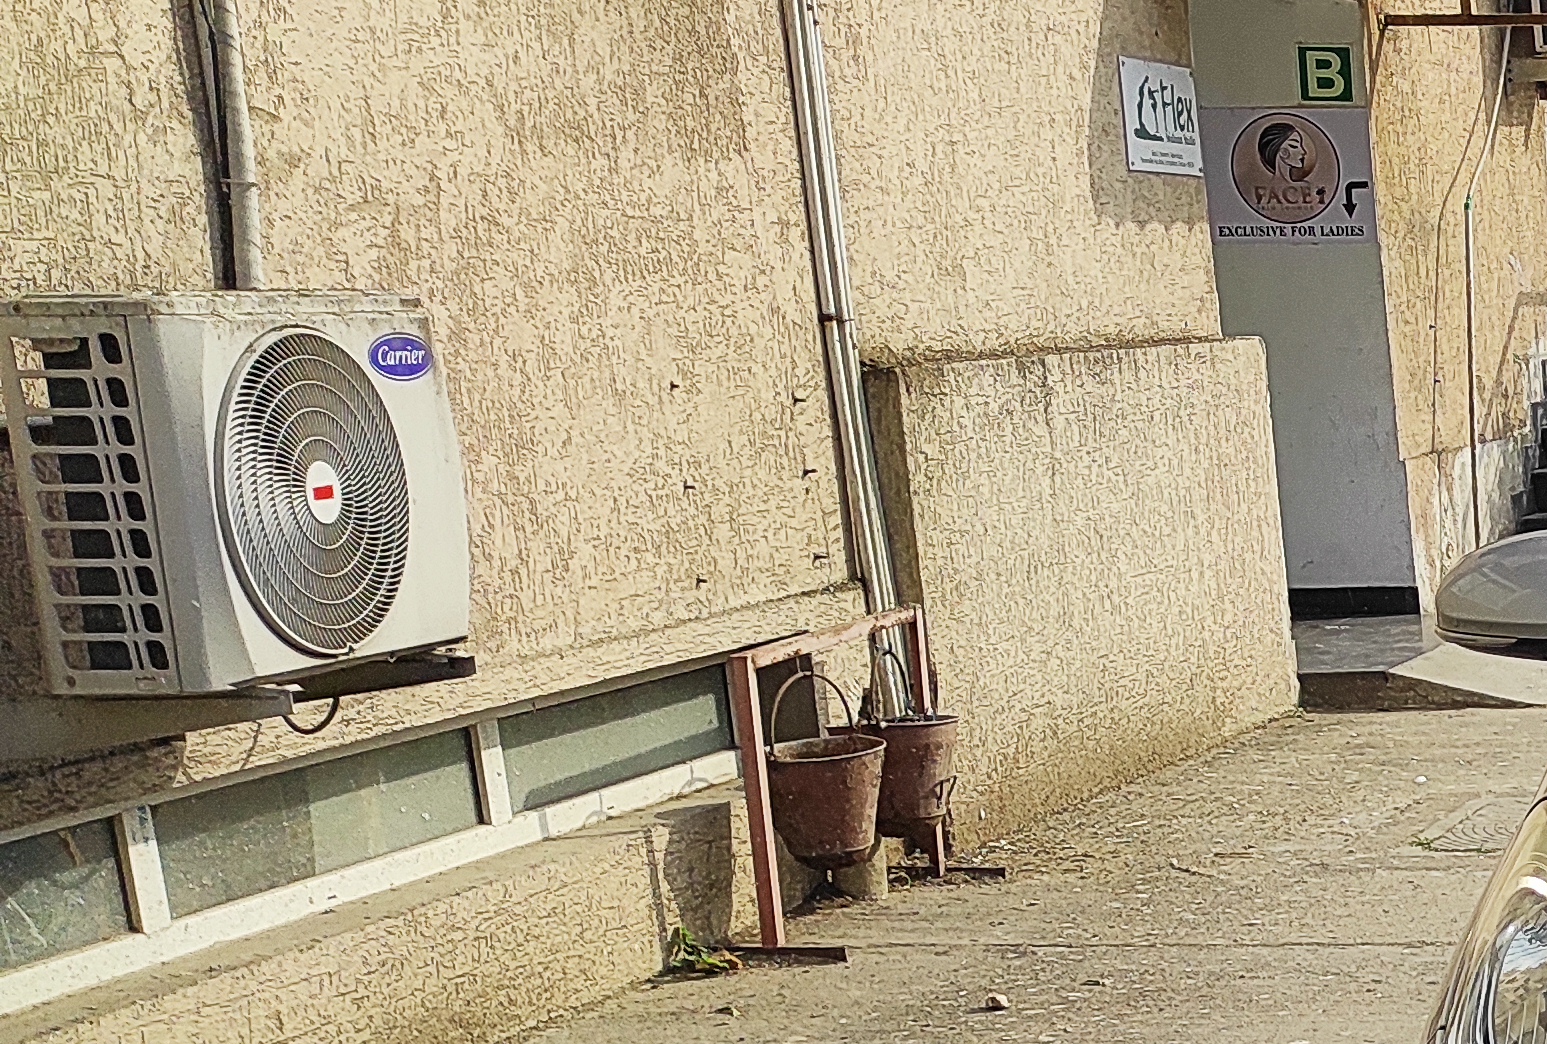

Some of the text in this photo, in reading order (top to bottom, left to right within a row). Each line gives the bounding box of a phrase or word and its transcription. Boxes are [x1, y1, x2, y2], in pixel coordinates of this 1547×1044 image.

[1306, 50, 1345, 97] B
[1217, 225, 1365, 237] EXCLUSIVE FOR LADIES
[377, 345, 426, 366] Carrier
